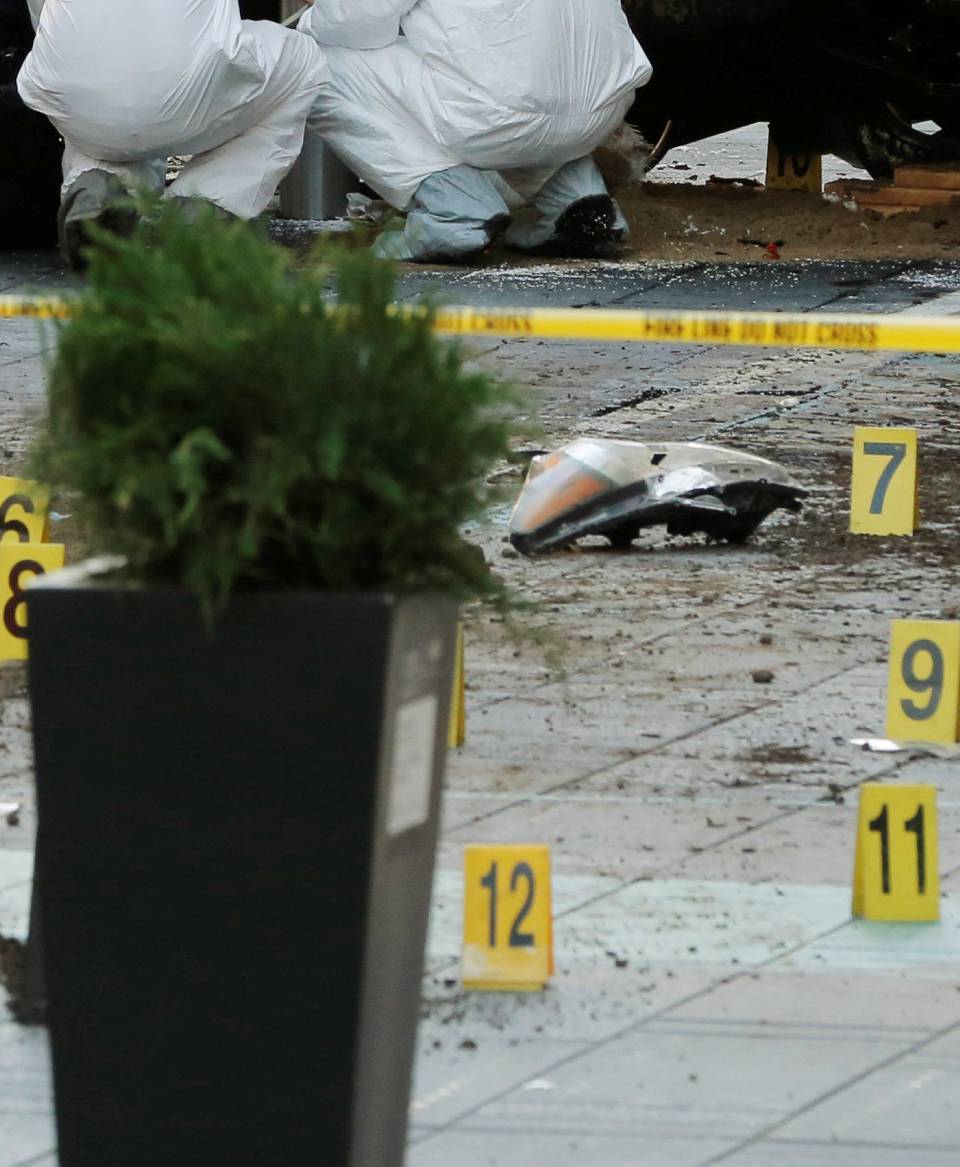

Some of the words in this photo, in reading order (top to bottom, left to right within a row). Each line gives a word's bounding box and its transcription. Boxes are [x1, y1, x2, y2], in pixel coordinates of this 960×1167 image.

[863, 442, 906, 515] 7
[900, 638, 944, 721] 9
[868, 802, 927, 896] 11
[480, 861, 536, 948] 12
